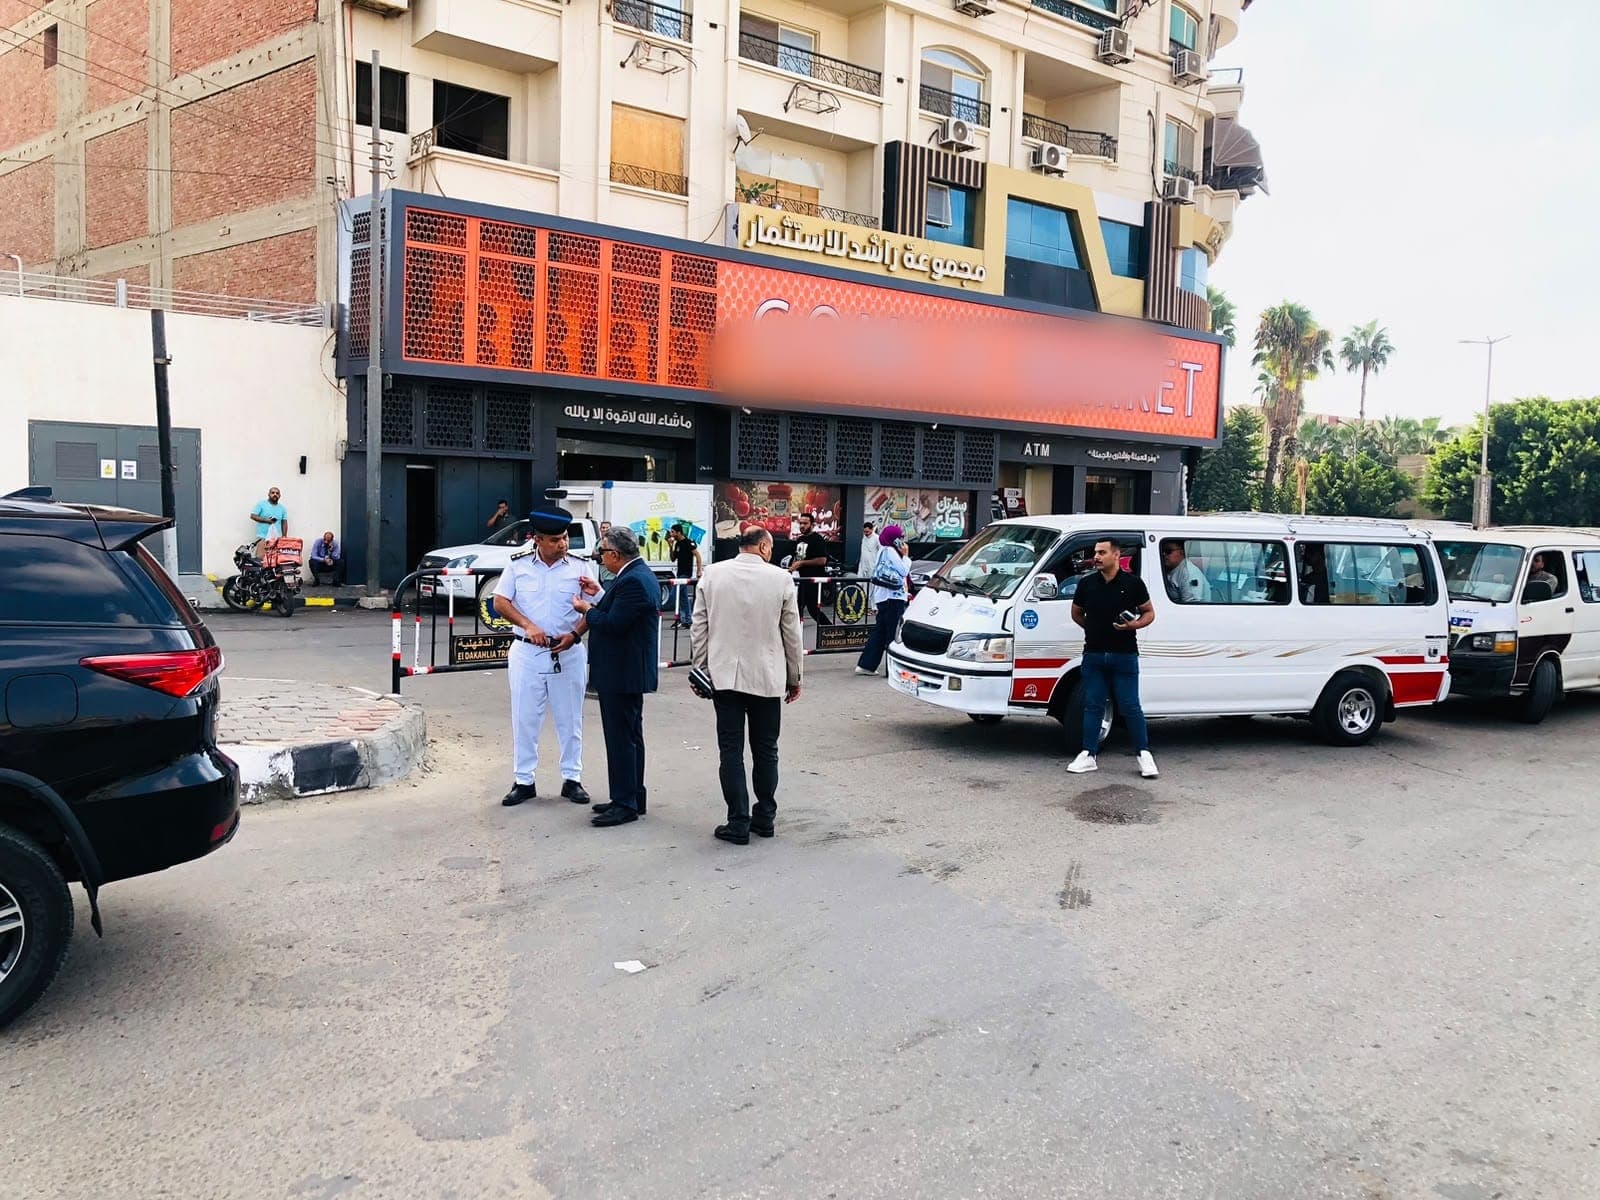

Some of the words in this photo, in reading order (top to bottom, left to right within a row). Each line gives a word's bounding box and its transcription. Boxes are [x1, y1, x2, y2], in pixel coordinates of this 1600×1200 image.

[744, 214, 848, 257] للاستثمار
[849, 233, 900, 272] راشد
[903, 243, 987, 287] مجموعة
[564, 404, 590, 422] بالله
[592, 407, 604, 425] إلا
[1023, 442, 1050, 457] ATM
[458, 638, 494, 650] الدقهلية
[465, 650, 497, 660] DAKAHLIA
